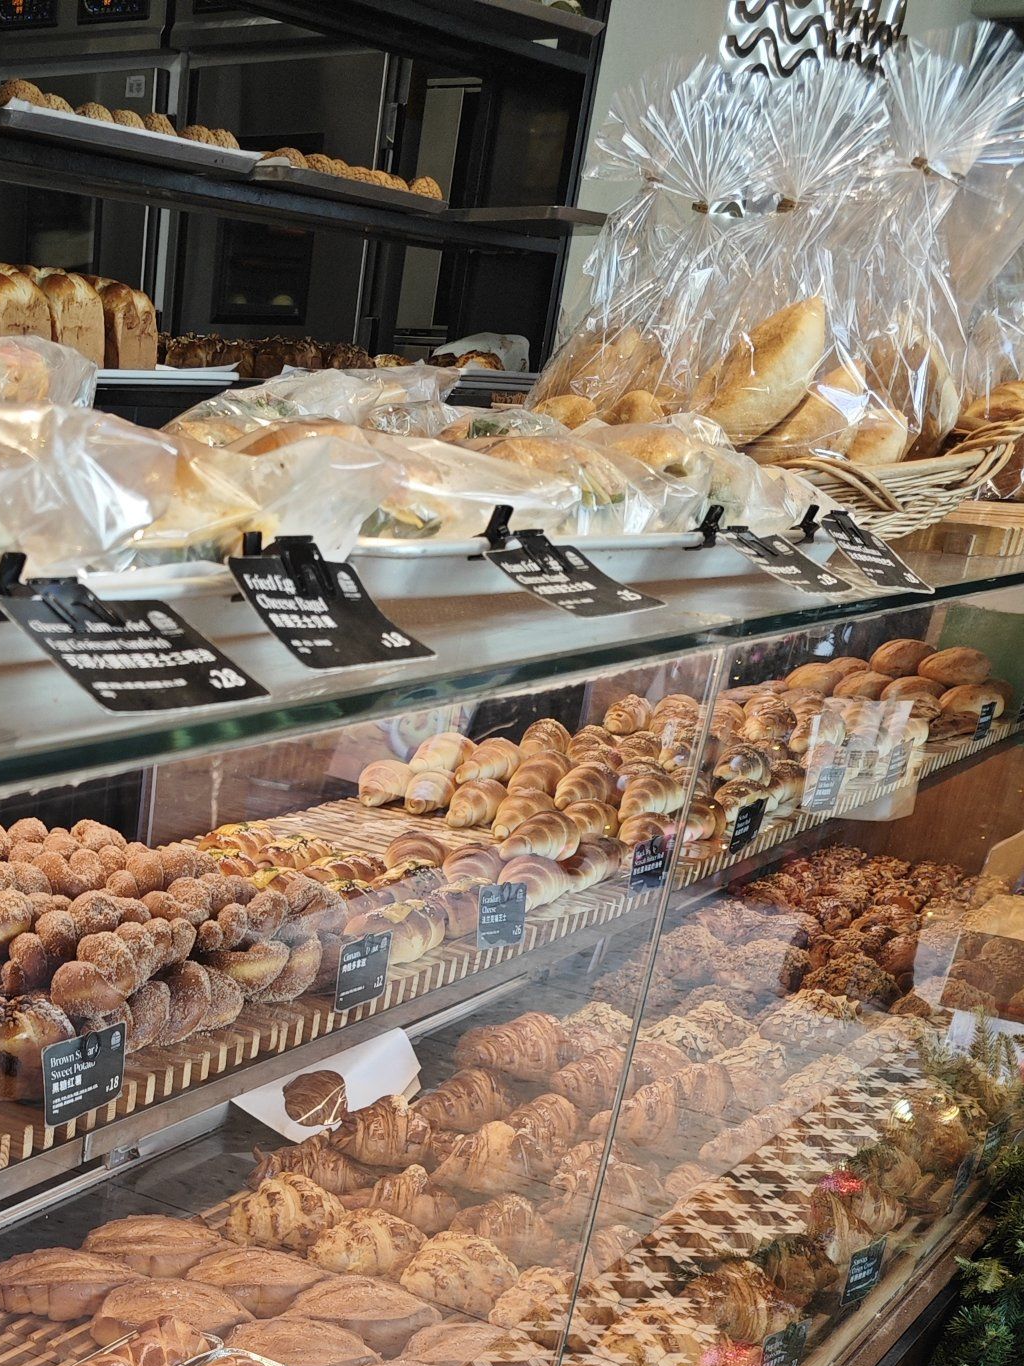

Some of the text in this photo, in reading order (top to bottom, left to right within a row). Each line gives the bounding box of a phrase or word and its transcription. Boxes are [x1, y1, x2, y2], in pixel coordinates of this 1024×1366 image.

[256, 594, 328, 613] Cheese Bagel
[50, 1053, 74, 1068] Brown
[51, 1066, 72, 1080] Sweet
[52, 1074, 82, 1094] 黑糖红薯
[106, 1076, 120, 1092] ¥18
